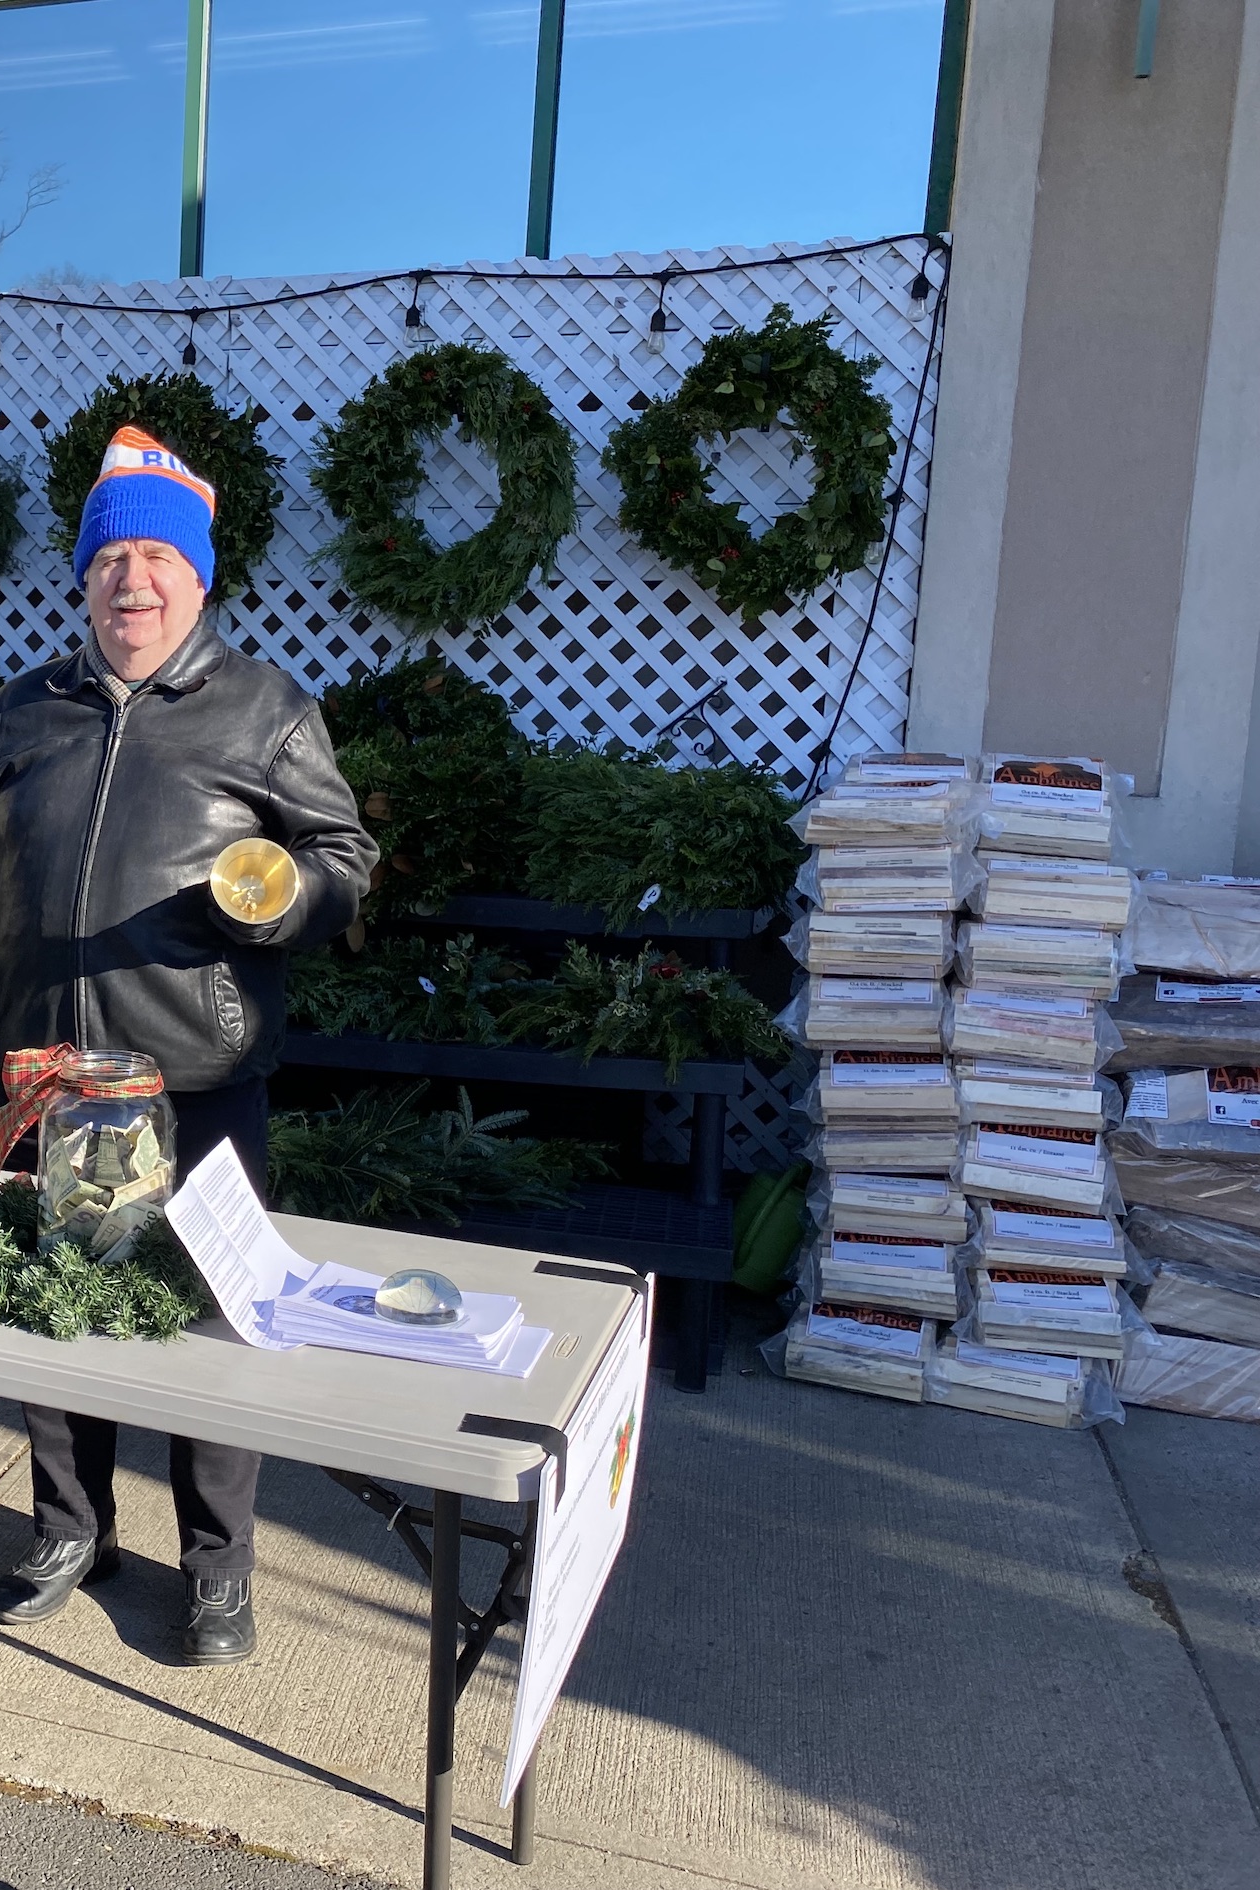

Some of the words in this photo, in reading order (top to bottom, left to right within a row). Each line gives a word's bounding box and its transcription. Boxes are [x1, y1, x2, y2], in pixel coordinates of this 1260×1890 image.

[997, 766, 1100, 790] Ambiance
[838, 1050, 941, 1064] Ambiance
[817, 1302, 920, 1330] Ambiance
